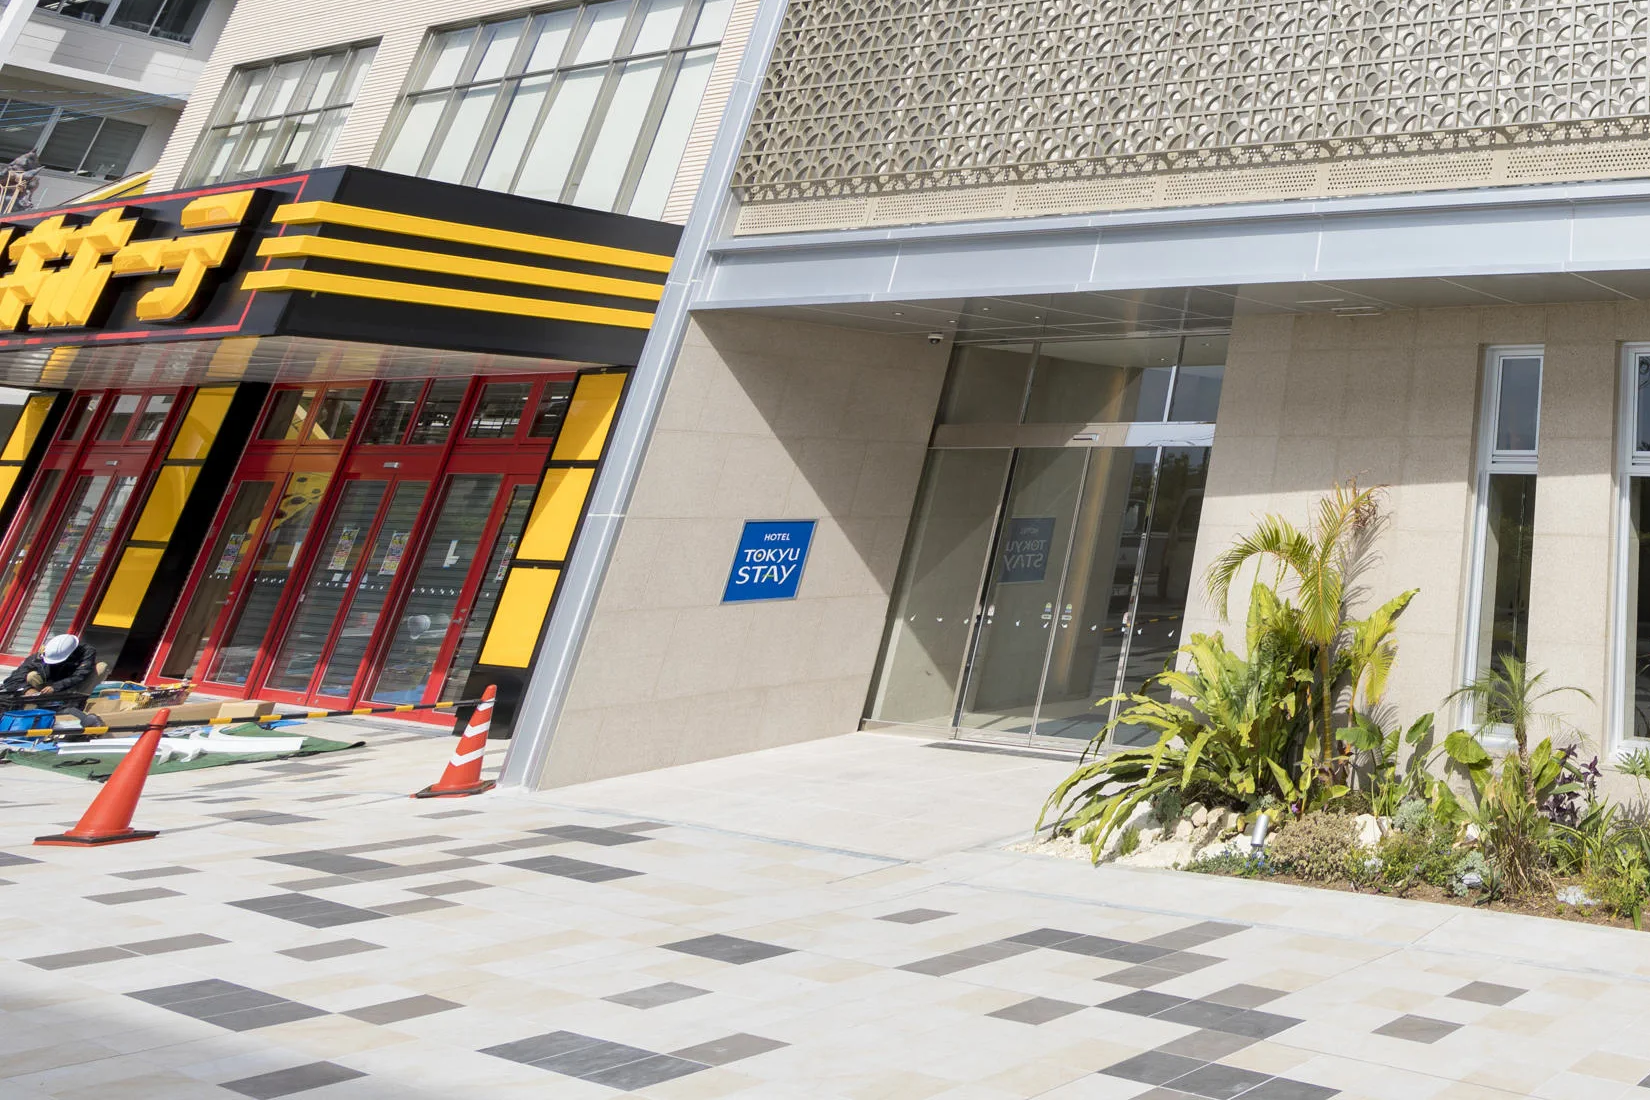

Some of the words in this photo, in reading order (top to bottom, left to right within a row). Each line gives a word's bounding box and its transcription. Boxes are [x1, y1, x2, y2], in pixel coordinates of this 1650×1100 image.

[0, 190, 255, 331] キホーテ
[764, 533, 790, 541] HOTEL
[743, 547, 801, 563] TOKYU
[735, 564, 797, 585] STAY
